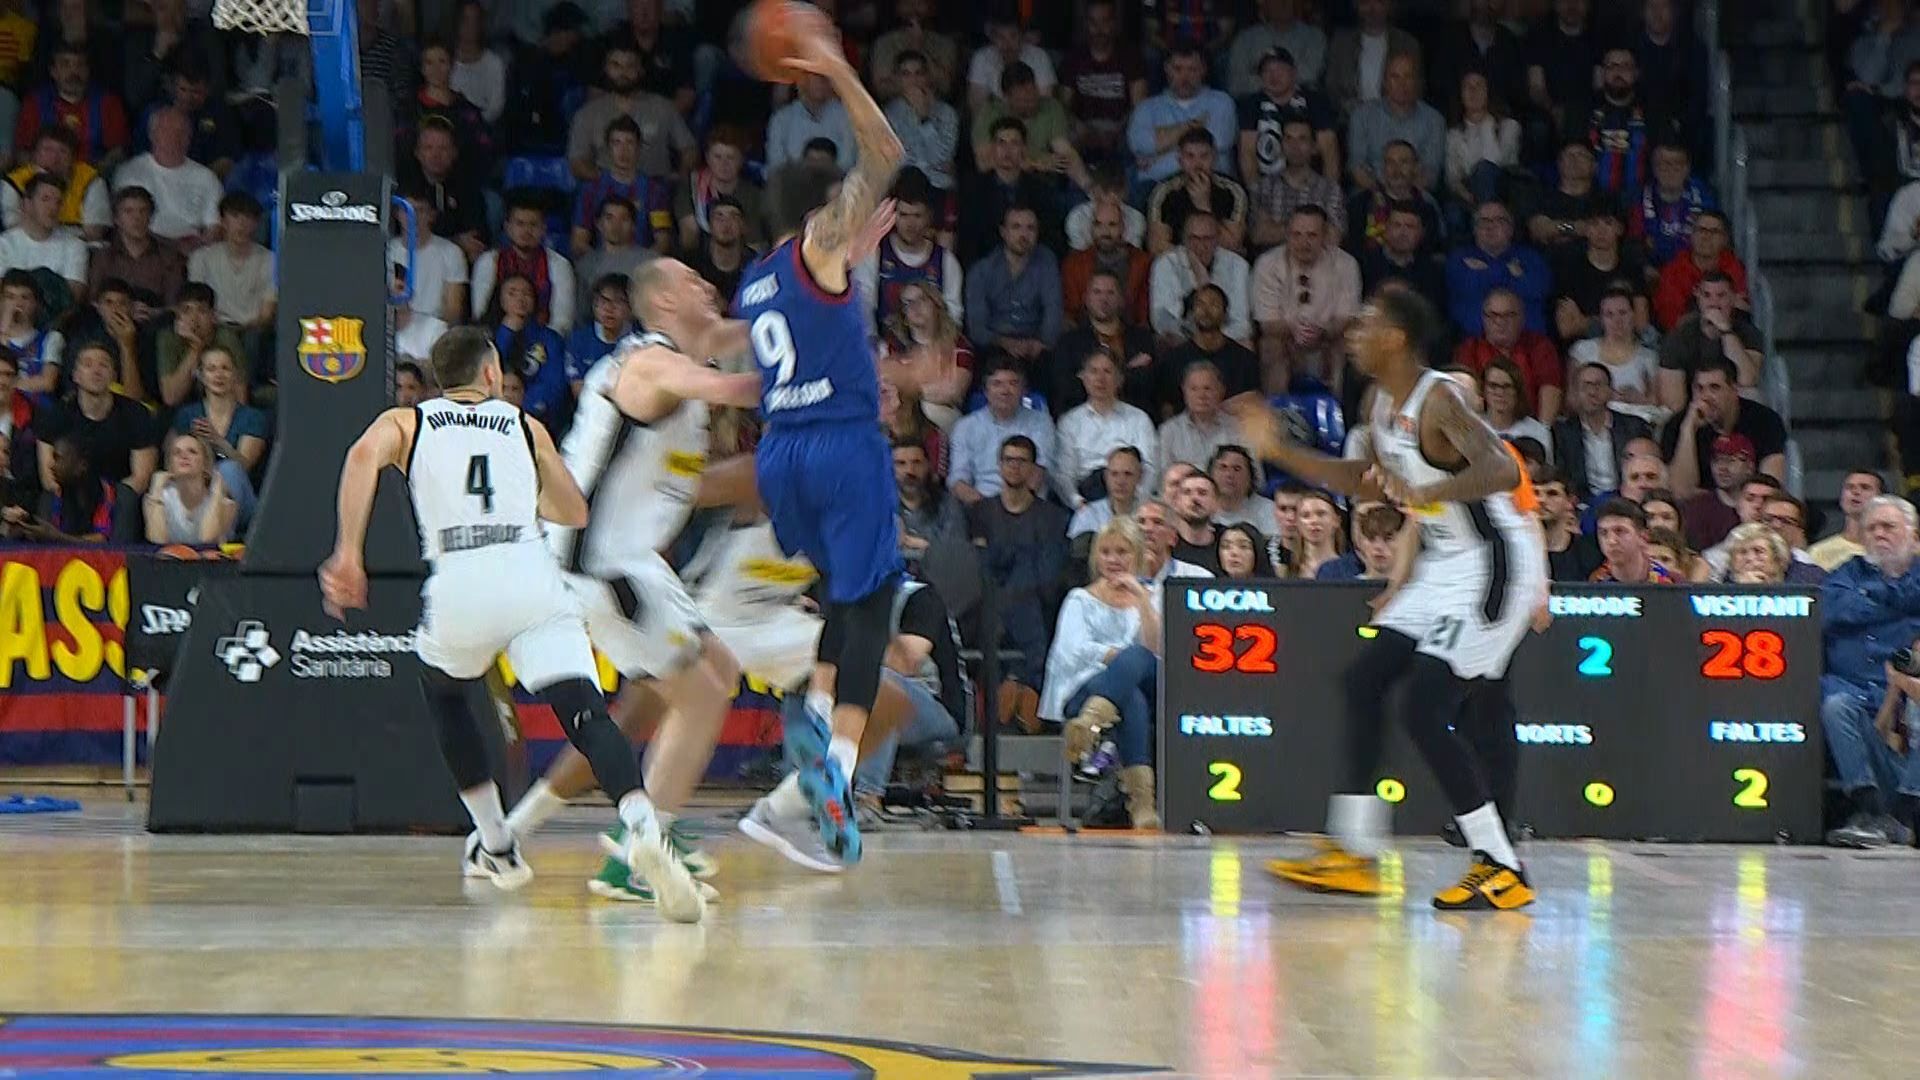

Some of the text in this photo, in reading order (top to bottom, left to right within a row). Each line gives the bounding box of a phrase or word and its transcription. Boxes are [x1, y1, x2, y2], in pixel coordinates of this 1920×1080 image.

[750, 309, 797, 387] 9
[465, 453, 496, 514] 4
[1186, 589, 1275, 611] LOCAL
[1549, 595, 1643, 617] ERIODE
[1690, 594, 1815, 617] VISITANT
[1192, 624, 1278, 673] 32
[1578, 636, 1613, 675] 2
[1701, 630, 1786, 679] 28
[1180, 714, 1273, 737] FALTES
[1710, 720, 1806, 743] FALTES
[1208, 762, 1242, 800] 2
[1376, 778, 1406, 803] 0
[1584, 782, 1615, 807] 0
[1733, 768, 1768, 807] 2
